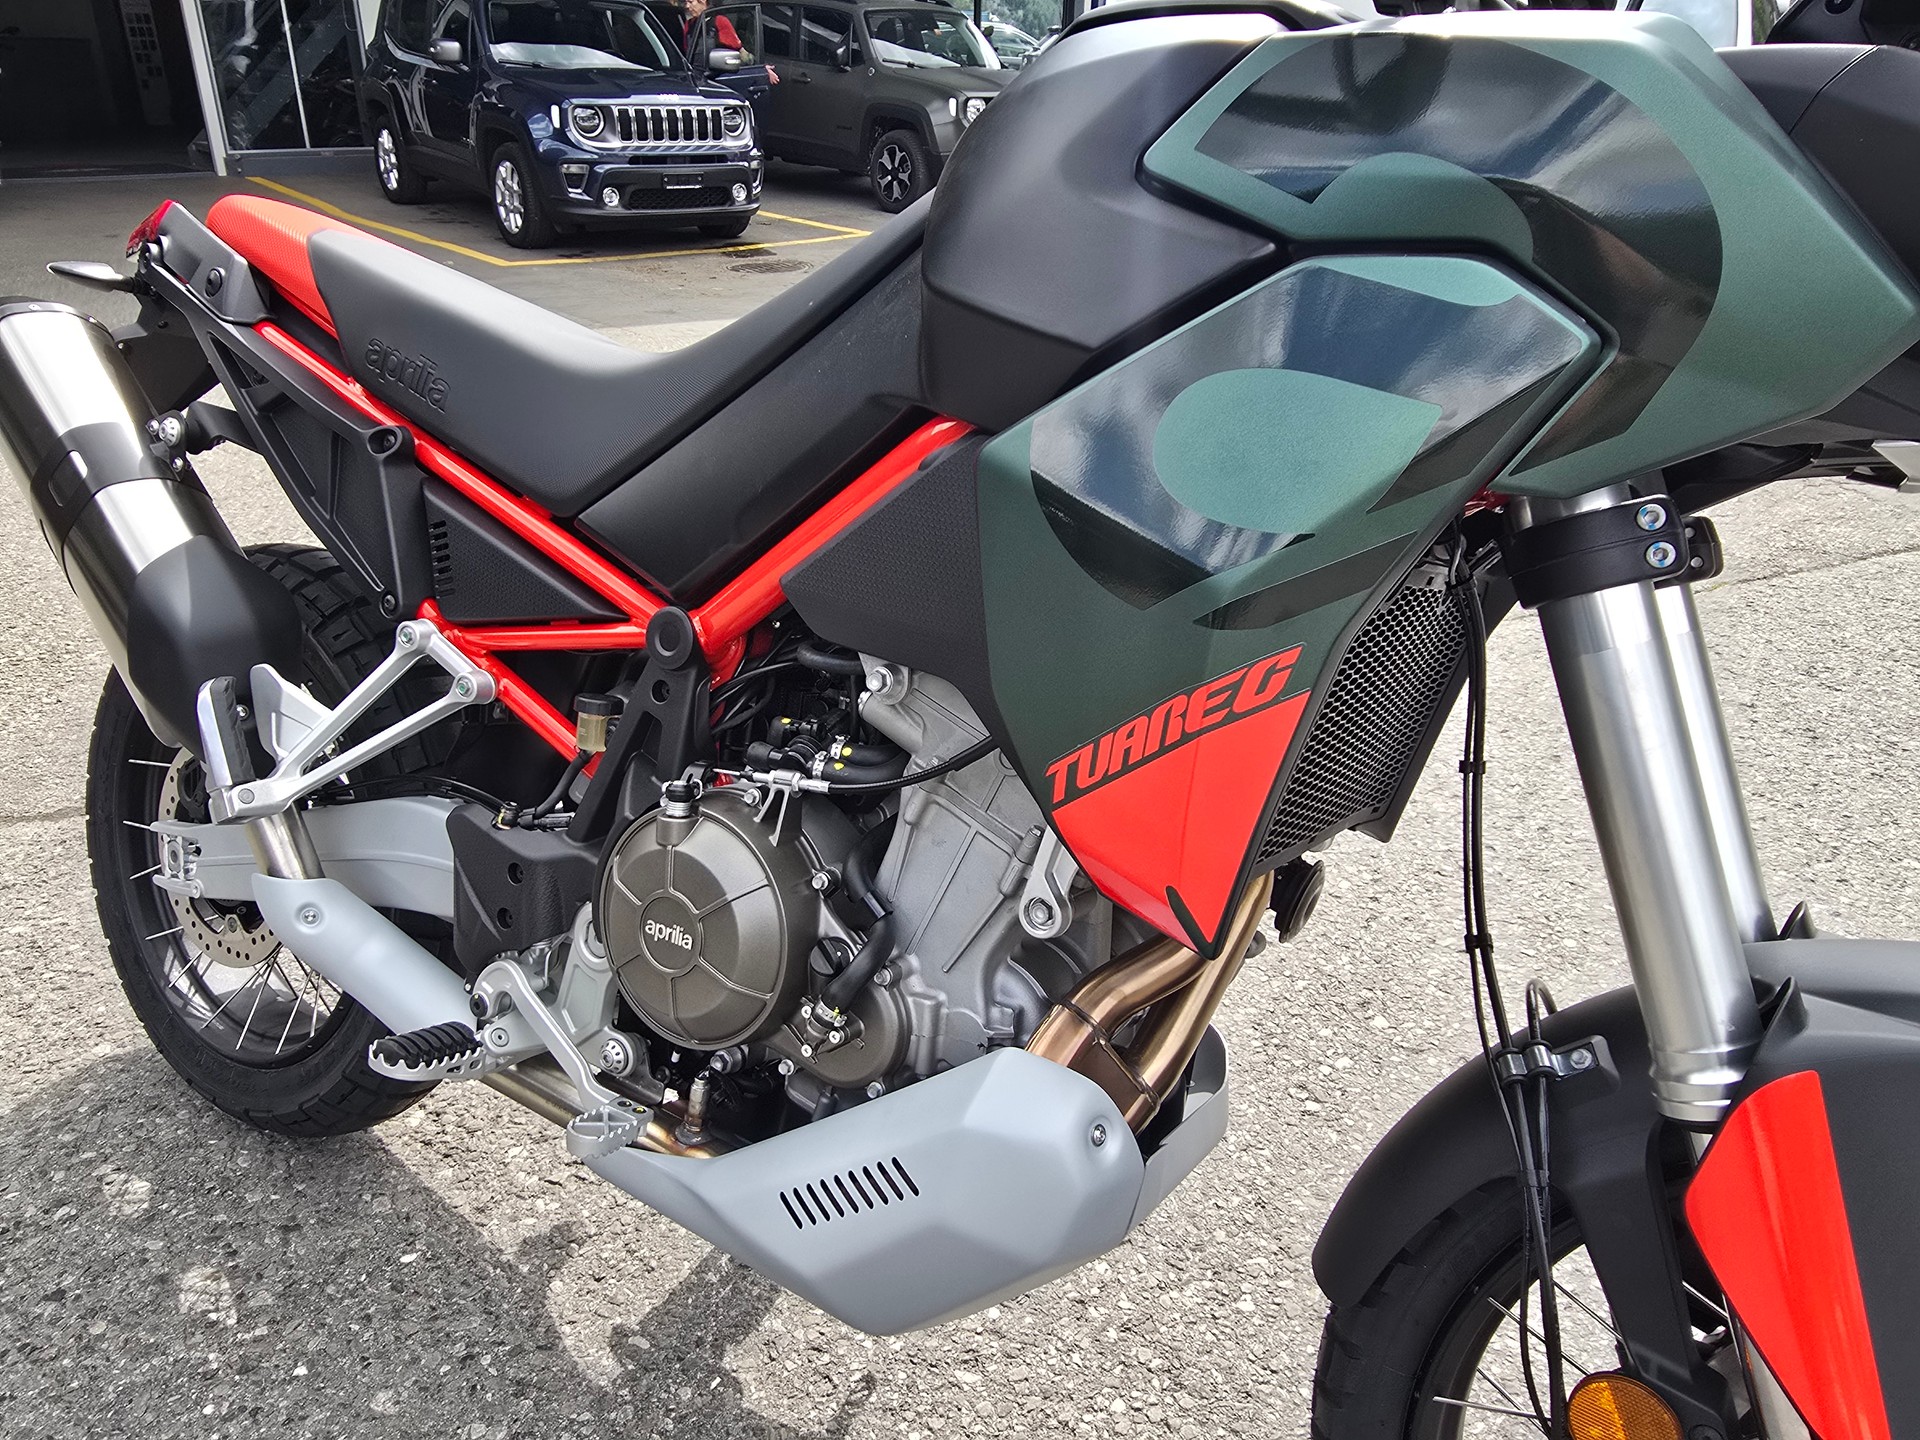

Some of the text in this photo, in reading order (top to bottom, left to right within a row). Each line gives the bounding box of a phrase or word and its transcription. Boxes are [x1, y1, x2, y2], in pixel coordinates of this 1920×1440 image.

[365, 338, 451, 414] aprilia
[1045, 646, 1303, 804] TUAREG
[645, 919, 693, 951] aprilia
